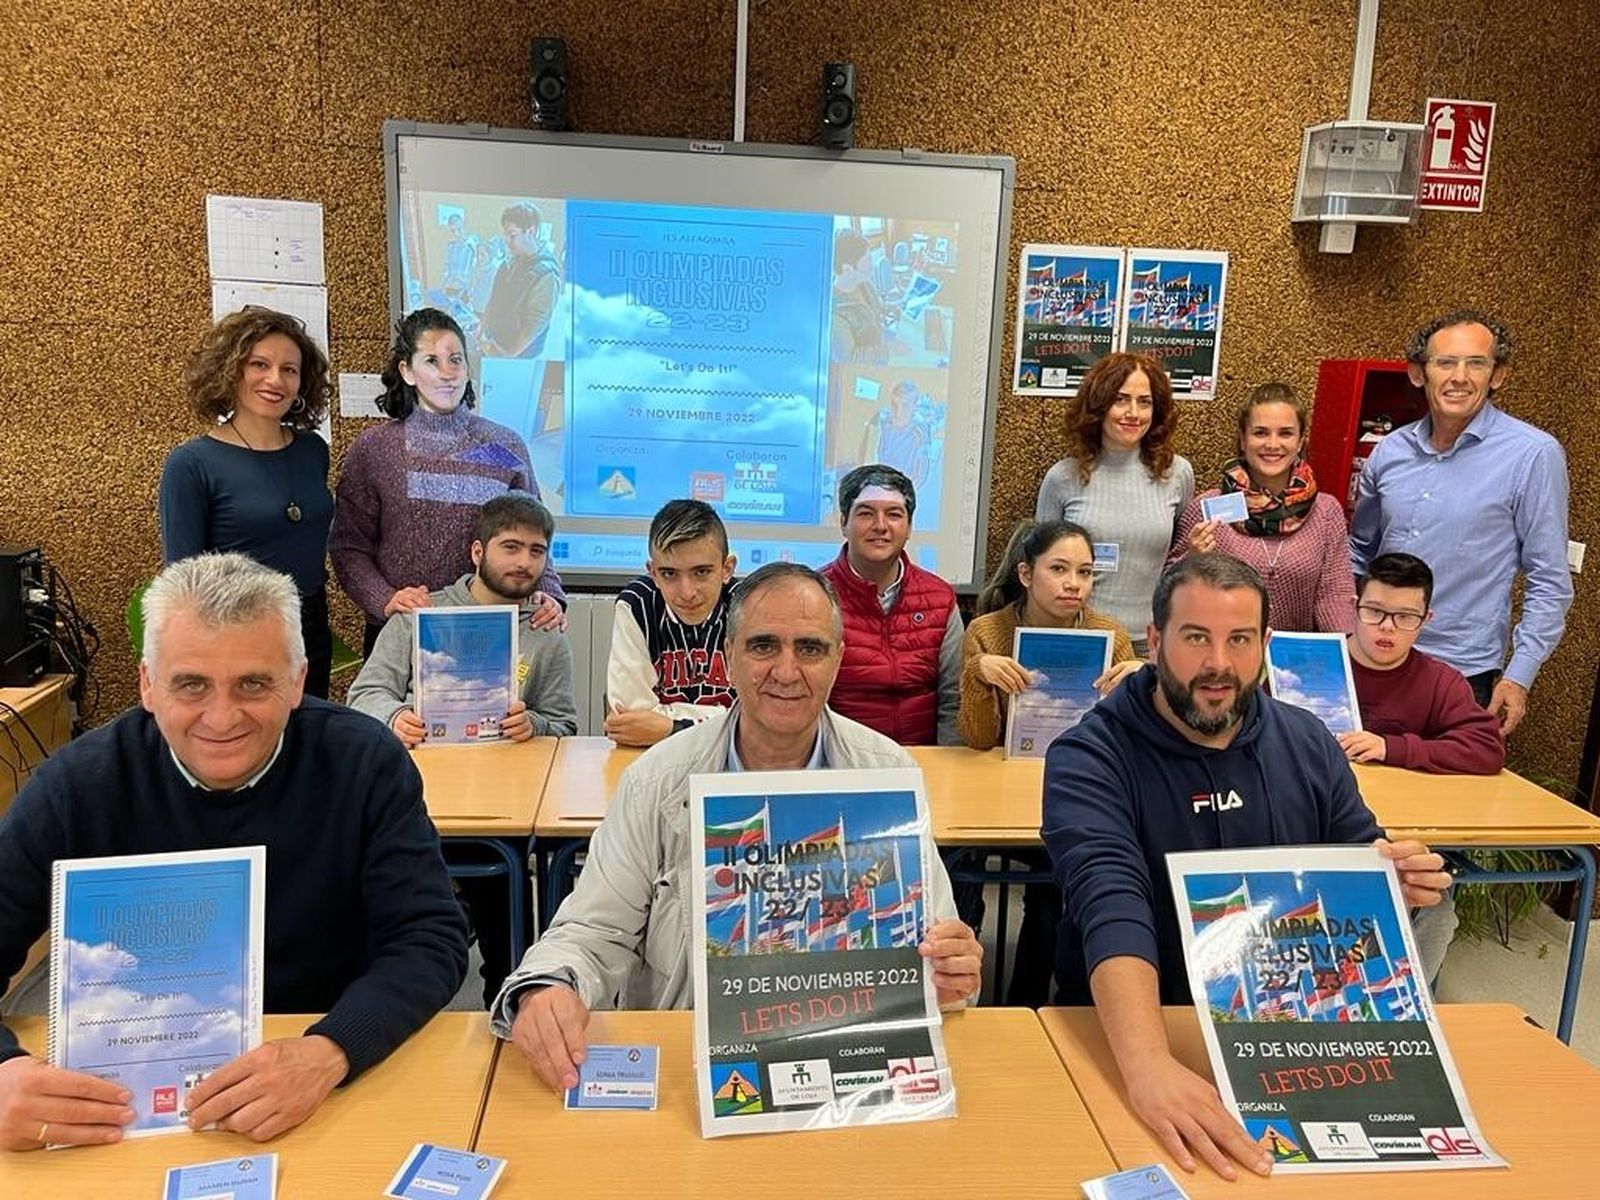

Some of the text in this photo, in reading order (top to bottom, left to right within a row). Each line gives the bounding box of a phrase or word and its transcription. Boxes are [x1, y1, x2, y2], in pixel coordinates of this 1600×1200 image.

[1422, 183, 1480, 202] EXTINTOR
[632, 250, 785, 287] OLIMPIADAS
[625, 278, 767, 313] INCLUSIVAS
[1028, 333, 1112, 344] 29 DE NOVIEMBRE 2022
[1132, 336, 1214, 347] 29 DE NOVIEMBRE 2022
[698, 362, 715, 373] Do
[627, 407, 642, 419] 29
[645, 408, 723, 422] NOVIEMBRE
[1191, 789, 1244, 814] FILA
[723, 840, 893, 867] II OLIMPIADAS
[733, 867, 880, 895] INCLUSIVAS
[112, 898, 218, 925] OLIMPIADAS
[105, 921, 210, 953] INCLUSIVAS
[1247, 916, 1376, 940] LIMPIADAS
[1251, 942, 1367, 965] CLUSIVAS
[722, 968, 920, 996] 29 DE NOVIEMBRE 2022
[740, 988, 876, 1036] LETS DO IT
[107, 1030, 200, 1048] 29 NOVIEMBRE 2022
[708, 1044, 759, 1057] ORGANIZA
[1233, 1040, 1433, 1058] 29 DE NOVIEMBRE 2022
[839, 1046, 886, 1058] COLABORAN
[1259, 1058, 1396, 1096] LETS DO IT
[1236, 1102, 1287, 1113] ORGANIZA
[1368, 1113, 1416, 1122] COLABORAN
